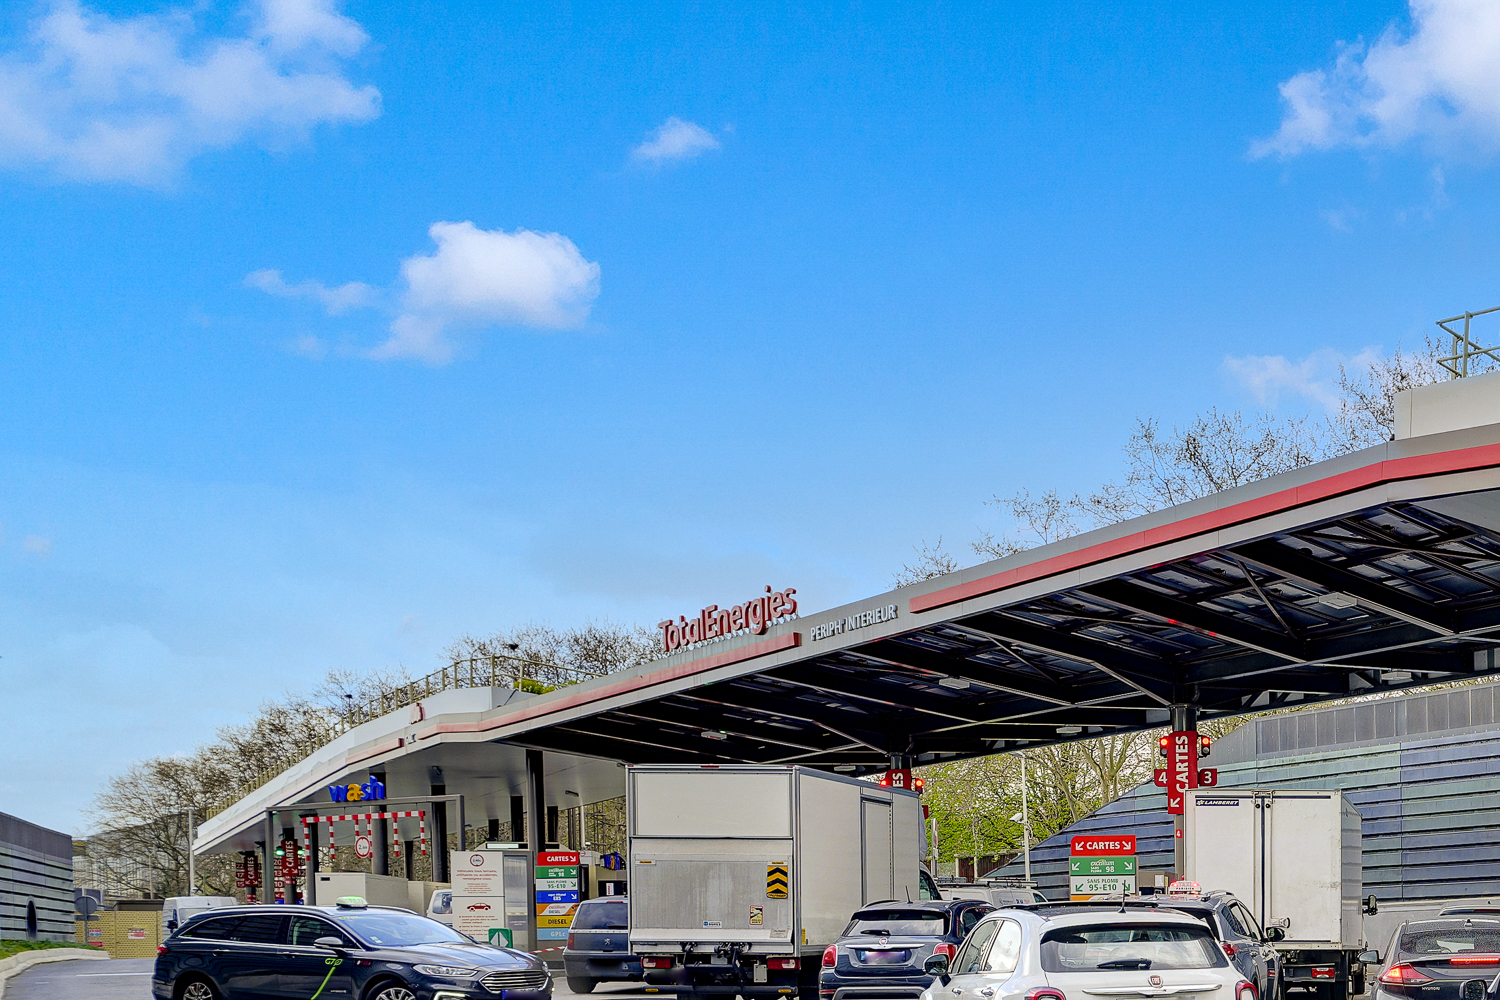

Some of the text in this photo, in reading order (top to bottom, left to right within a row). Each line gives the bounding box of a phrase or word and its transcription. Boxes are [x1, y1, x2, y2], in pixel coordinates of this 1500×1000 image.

[658, 585, 798, 651] TotalEnergies
[1175, 735, 1189, 794] CARTES
[328, 775, 385, 802] wash
[1158, 771, 1168, 784] 4
[1203, 771, 1213, 784] 3
[285, 840, 294, 867] CARTES
[1086, 841, 1121, 850] CARTES
[247, 857, 255, 880] CARTES
